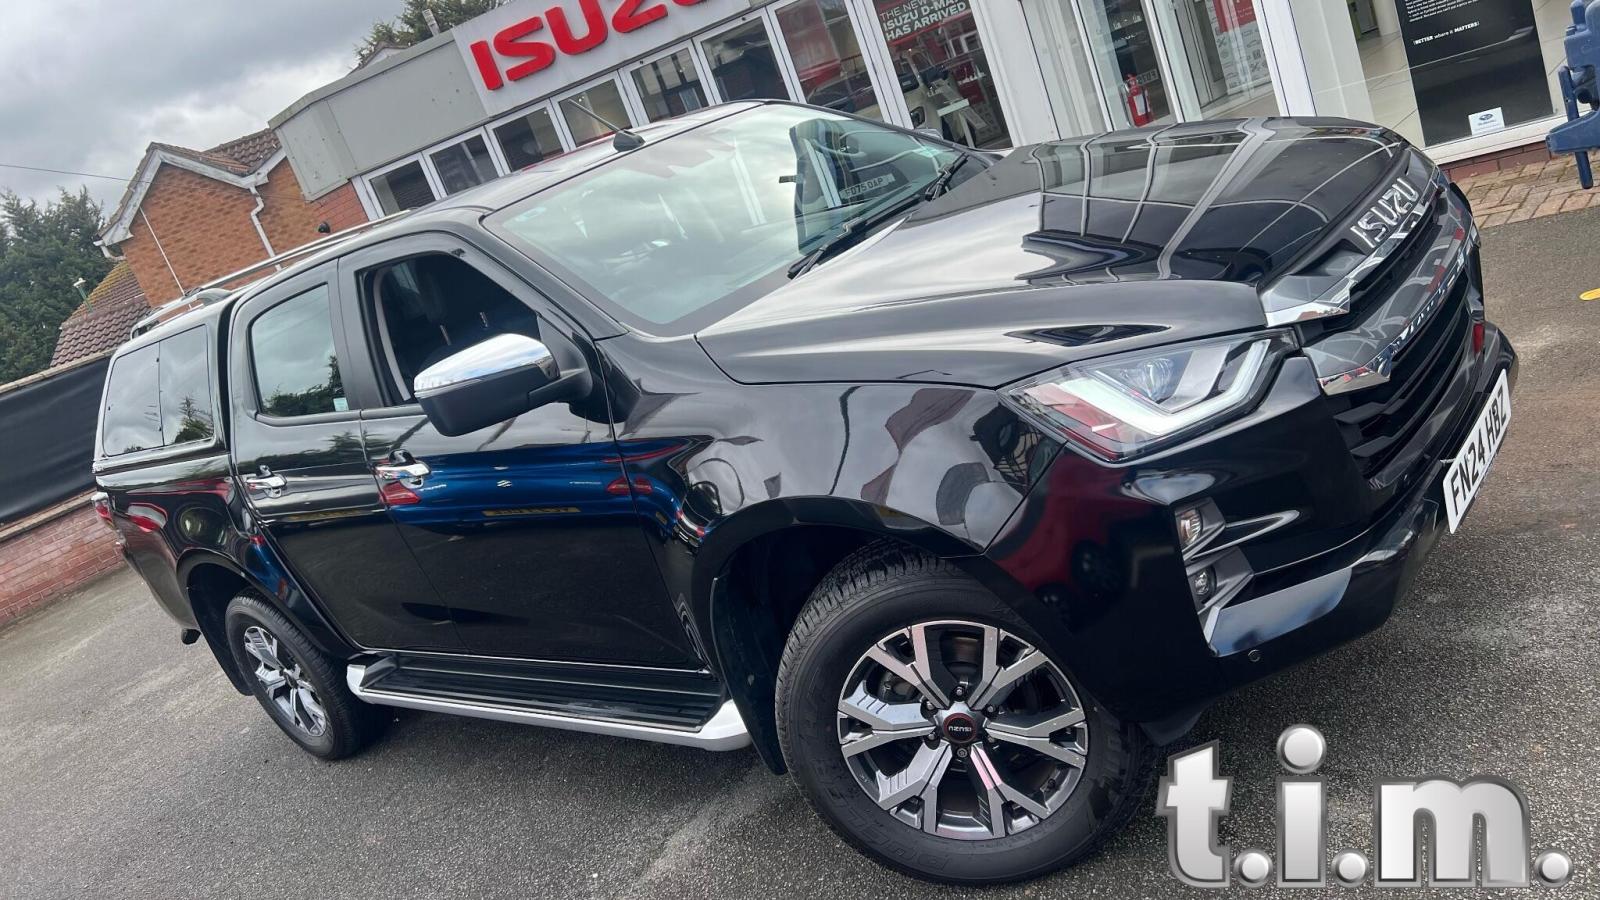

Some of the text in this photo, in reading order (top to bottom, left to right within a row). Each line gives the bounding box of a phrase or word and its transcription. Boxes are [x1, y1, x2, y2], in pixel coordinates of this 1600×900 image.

[880, 7, 902, 20] THE
[882, 9, 919, 32] ISUZU
[885, 2, 967, 41] HAS ARRIVED
[1350, 178, 1419, 248] ISUZU
[1450, 385, 1507, 517] FN24 HBZ
